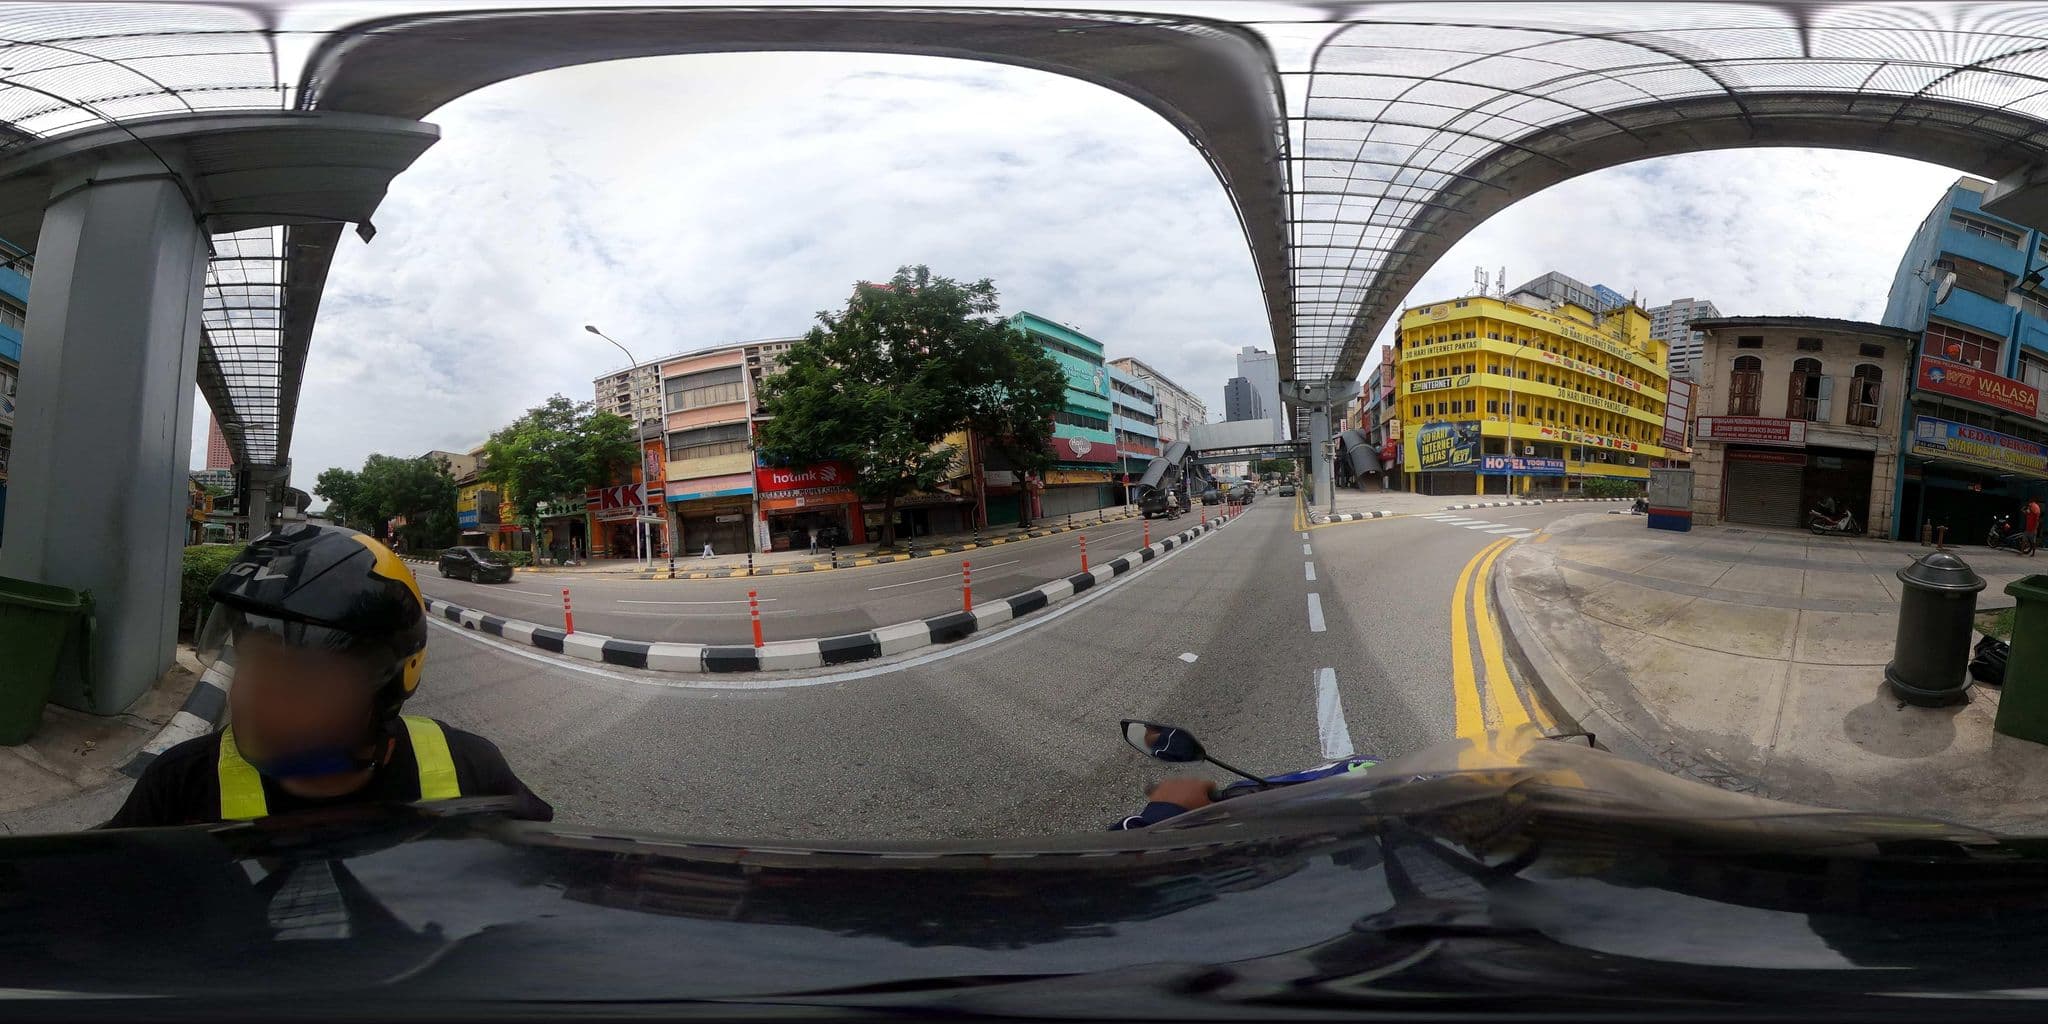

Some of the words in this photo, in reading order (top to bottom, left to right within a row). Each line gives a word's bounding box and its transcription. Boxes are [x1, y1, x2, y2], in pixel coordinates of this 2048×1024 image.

[1427, 345, 1453, 355] INTERNET
[1454, 341, 1477, 350] PANTAS
[1583, 335, 1606, 350] INTERNET
[1566, 391, 1579, 401] HARI
[1580, 393, 1603, 406] INTERNET
[1979, 377, 2036, 406] WALASA
[1422, 437, 1455, 455] INTERNET
[1422, 450, 1446, 465] PANTAS
[773, 470, 817, 484] hotlink
[602, 483, 643, 510] KK
